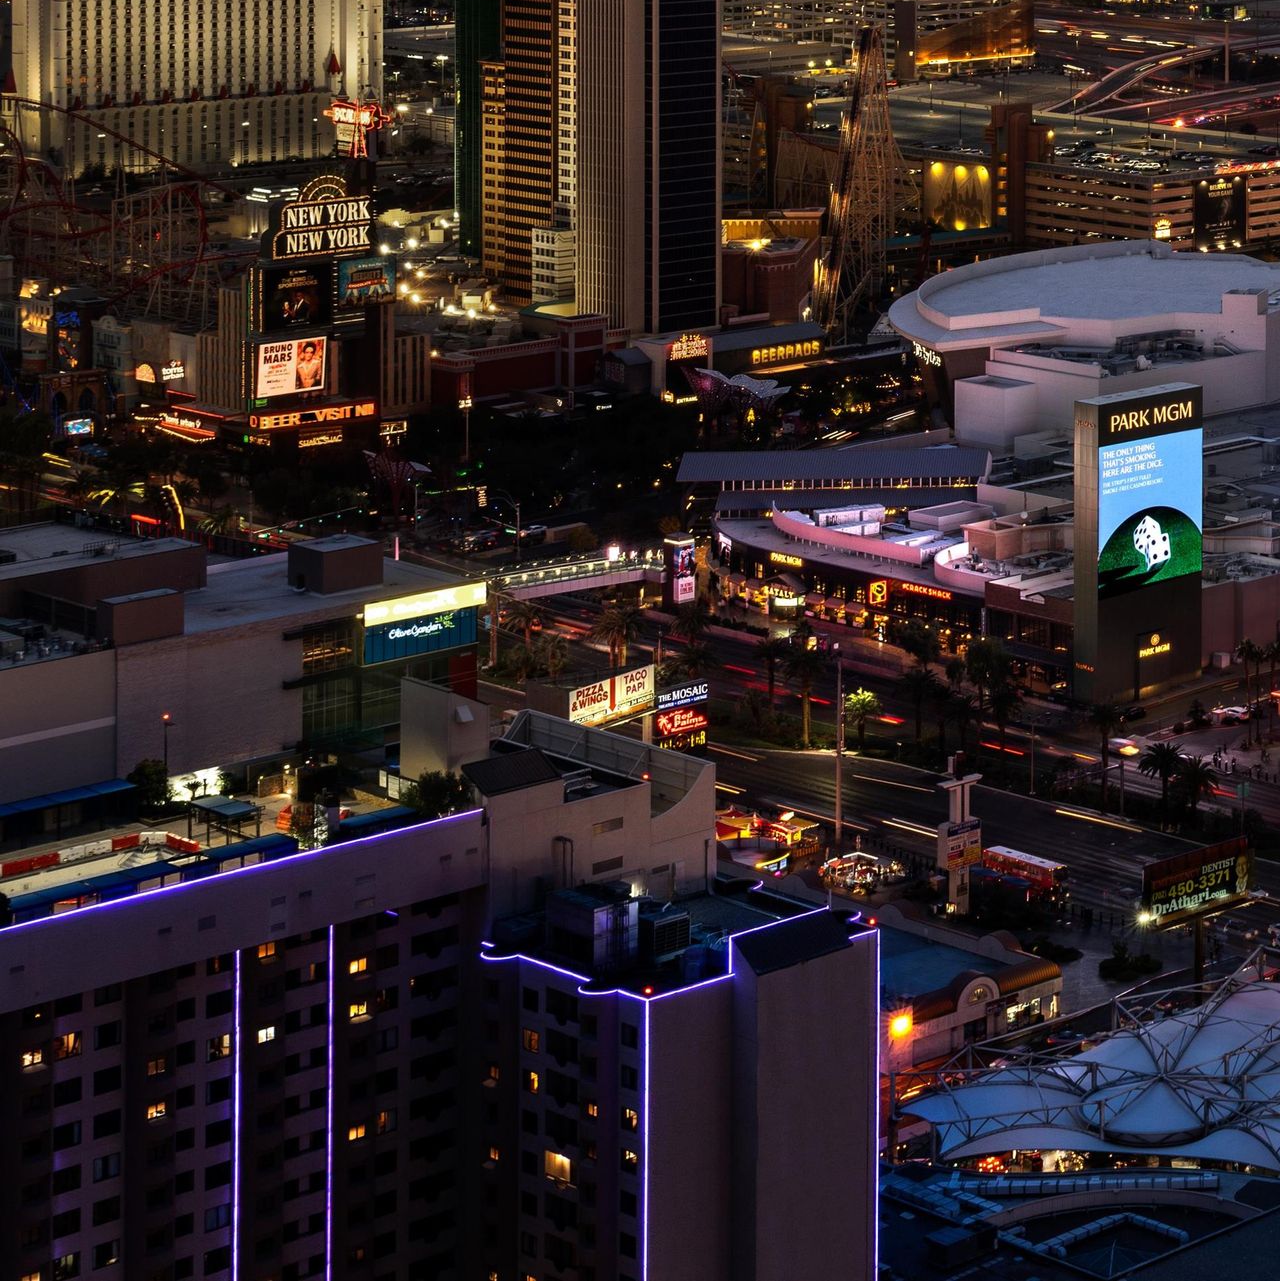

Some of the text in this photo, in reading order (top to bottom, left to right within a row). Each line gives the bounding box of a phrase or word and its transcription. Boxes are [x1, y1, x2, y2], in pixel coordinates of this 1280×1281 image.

[286, 200, 371, 228] NEW YORK
[286, 226, 371, 254] NEW YORK
[264, 343, 293, 355] BRUNO
[263, 352, 293, 365] MARS
[162, 366, 184, 375] toms
[163, 372, 184, 380] urban
[1110, 401, 1193, 433] PARK MGM
[1103, 442, 1156, 460] THE ONLY THING
[1103, 451, 1156, 469] THAT'S SMOKING
[1103, 467, 1119, 478] HERE
[1120, 465, 1134, 475] ARE
[1134, 463, 1146, 471] THE
[770, 552, 803, 567] PARK MGM
[905, 583, 952, 600] CRACK SHACK
[411, 621, 443, 637] Garden
[1139, 643, 1171, 658] PARK MGM
[624, 669, 648, 685] TACO
[576, 683, 605, 701] PIZZA
[626, 681, 645, 696] PAPI
[658, 684, 709, 703] THE MOSAIC
[571, 691, 608, 712] & WINGS
[674, 711, 693, 721] Red
[674, 716, 703, 728] Palms
[1202, 856, 1236, 875] DENTIST
[1168, 869, 1230, 898] 450-3371
[1151, 887, 1228, 918] DrAthari.com
